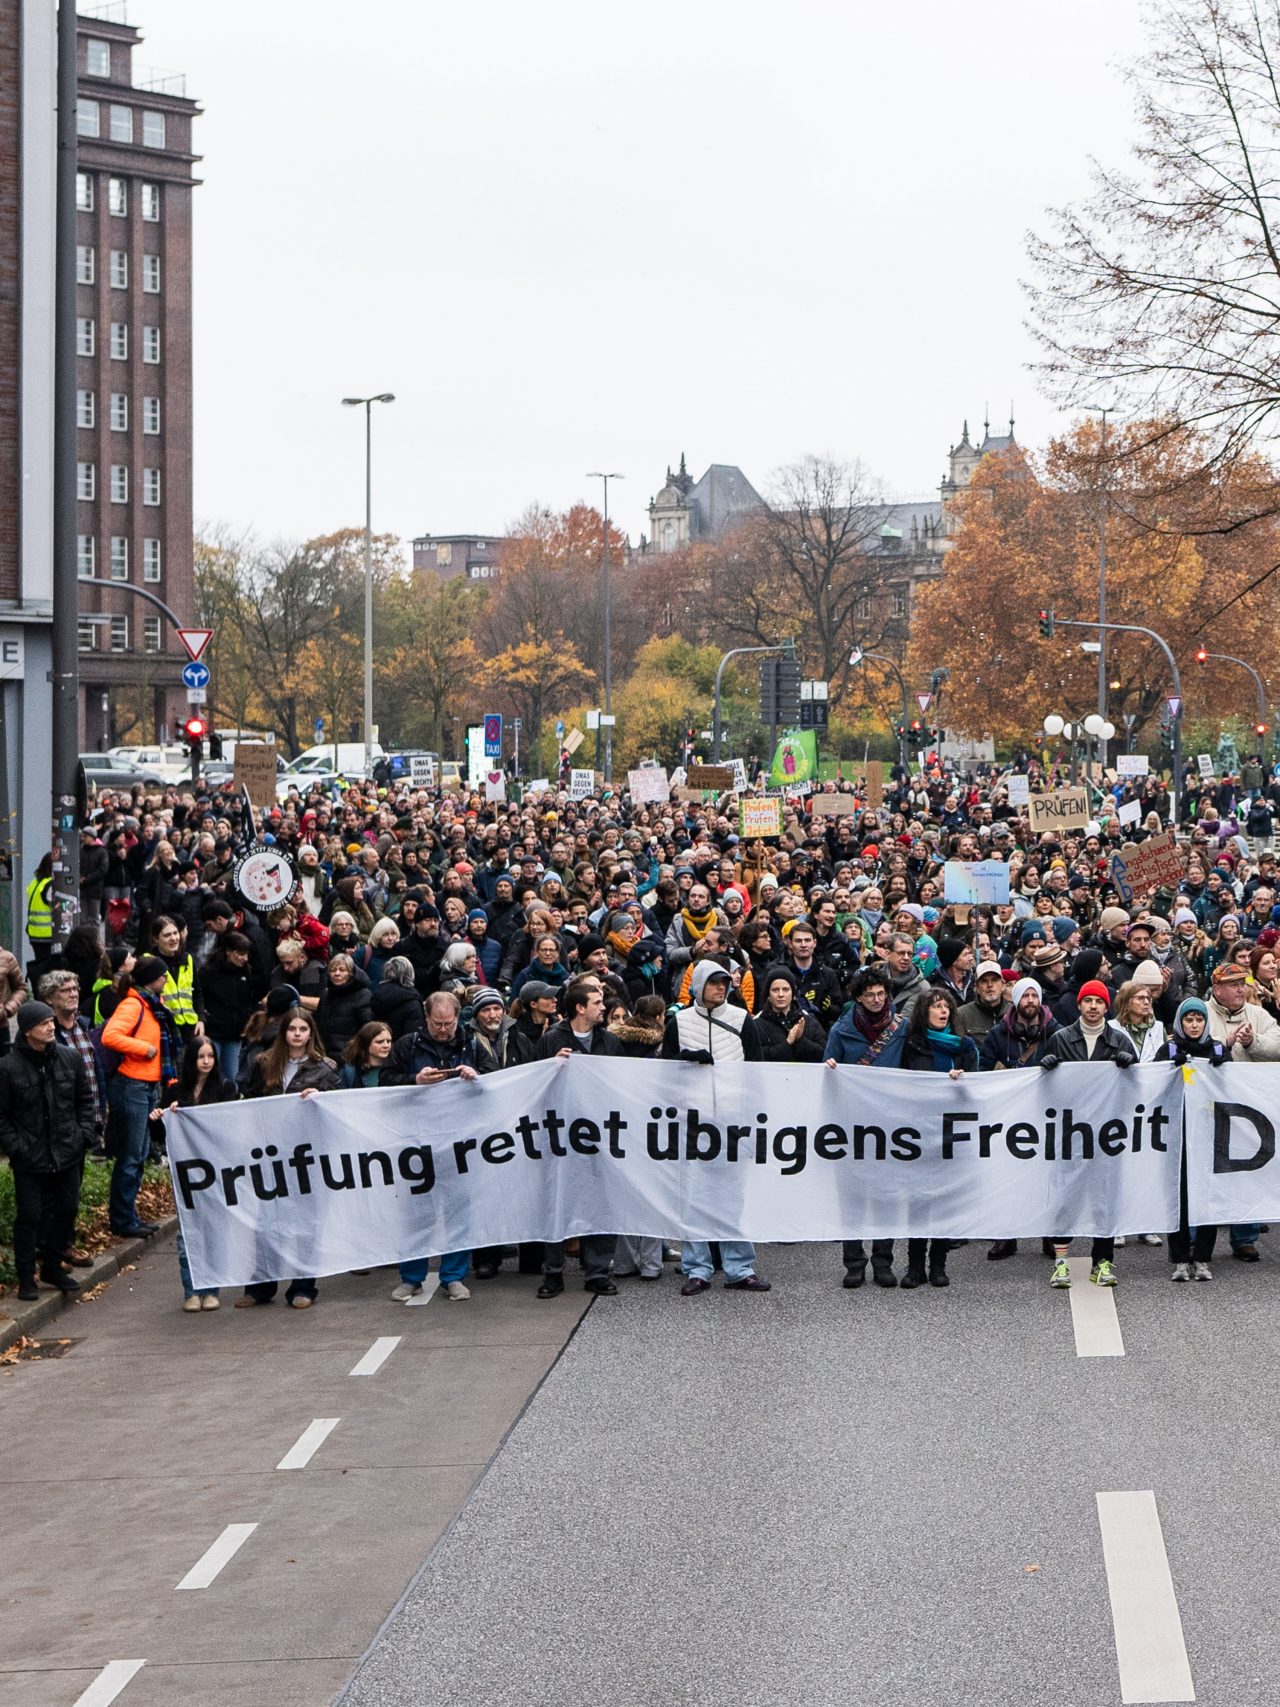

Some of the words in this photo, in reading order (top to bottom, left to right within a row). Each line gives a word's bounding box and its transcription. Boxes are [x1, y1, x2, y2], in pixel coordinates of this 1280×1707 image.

[486, 744, 500, 754] TAXI
[572, 788, 592, 796] RECHTS
[744, 799, 777, 811] Prüfen!
[1033, 795, 1087, 820] PRÜFEN!
[744, 811, 777, 823] Prüfen!
[176, 1143, 436, 1209] Prüfung
[453, 1109, 628, 1174] rettet
[646, 1106, 921, 1175] übrigens
[942, 1104, 1170, 1160] Freiheit
